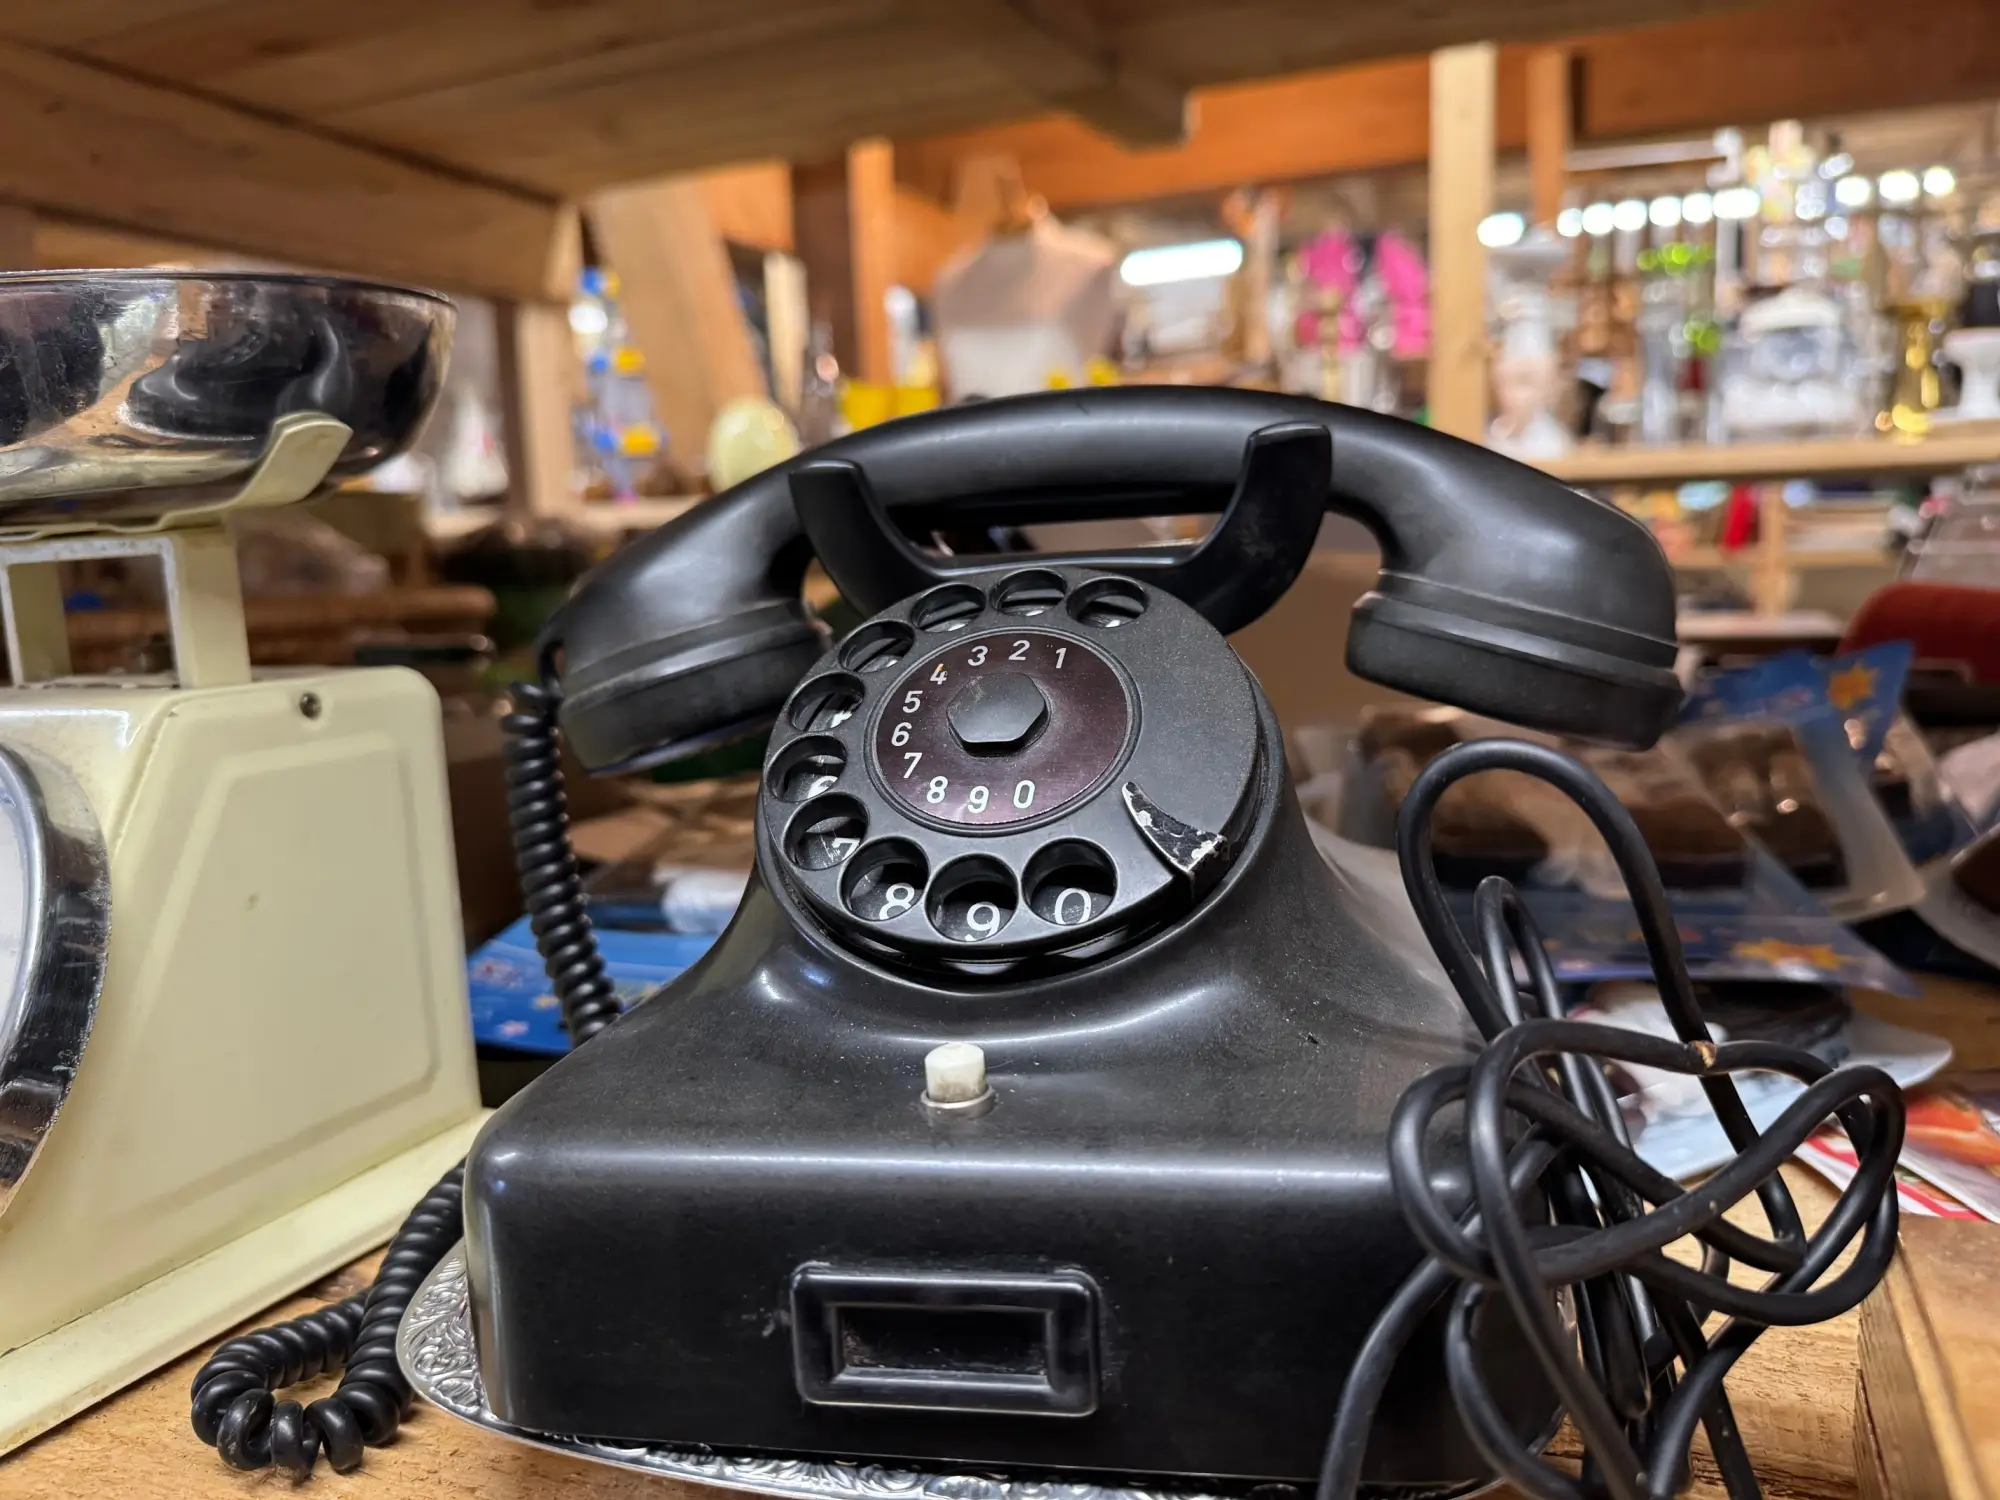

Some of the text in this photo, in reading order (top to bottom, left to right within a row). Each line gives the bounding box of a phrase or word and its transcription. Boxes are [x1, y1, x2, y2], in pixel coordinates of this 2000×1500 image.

[891, 639, 1067, 814] 1 2 3 4 5 6 7 8 9 0
[878, 882, 915, 921] 8
[964, 901, 1001, 942] 9
[1054, 887, 1092, 926] 0
